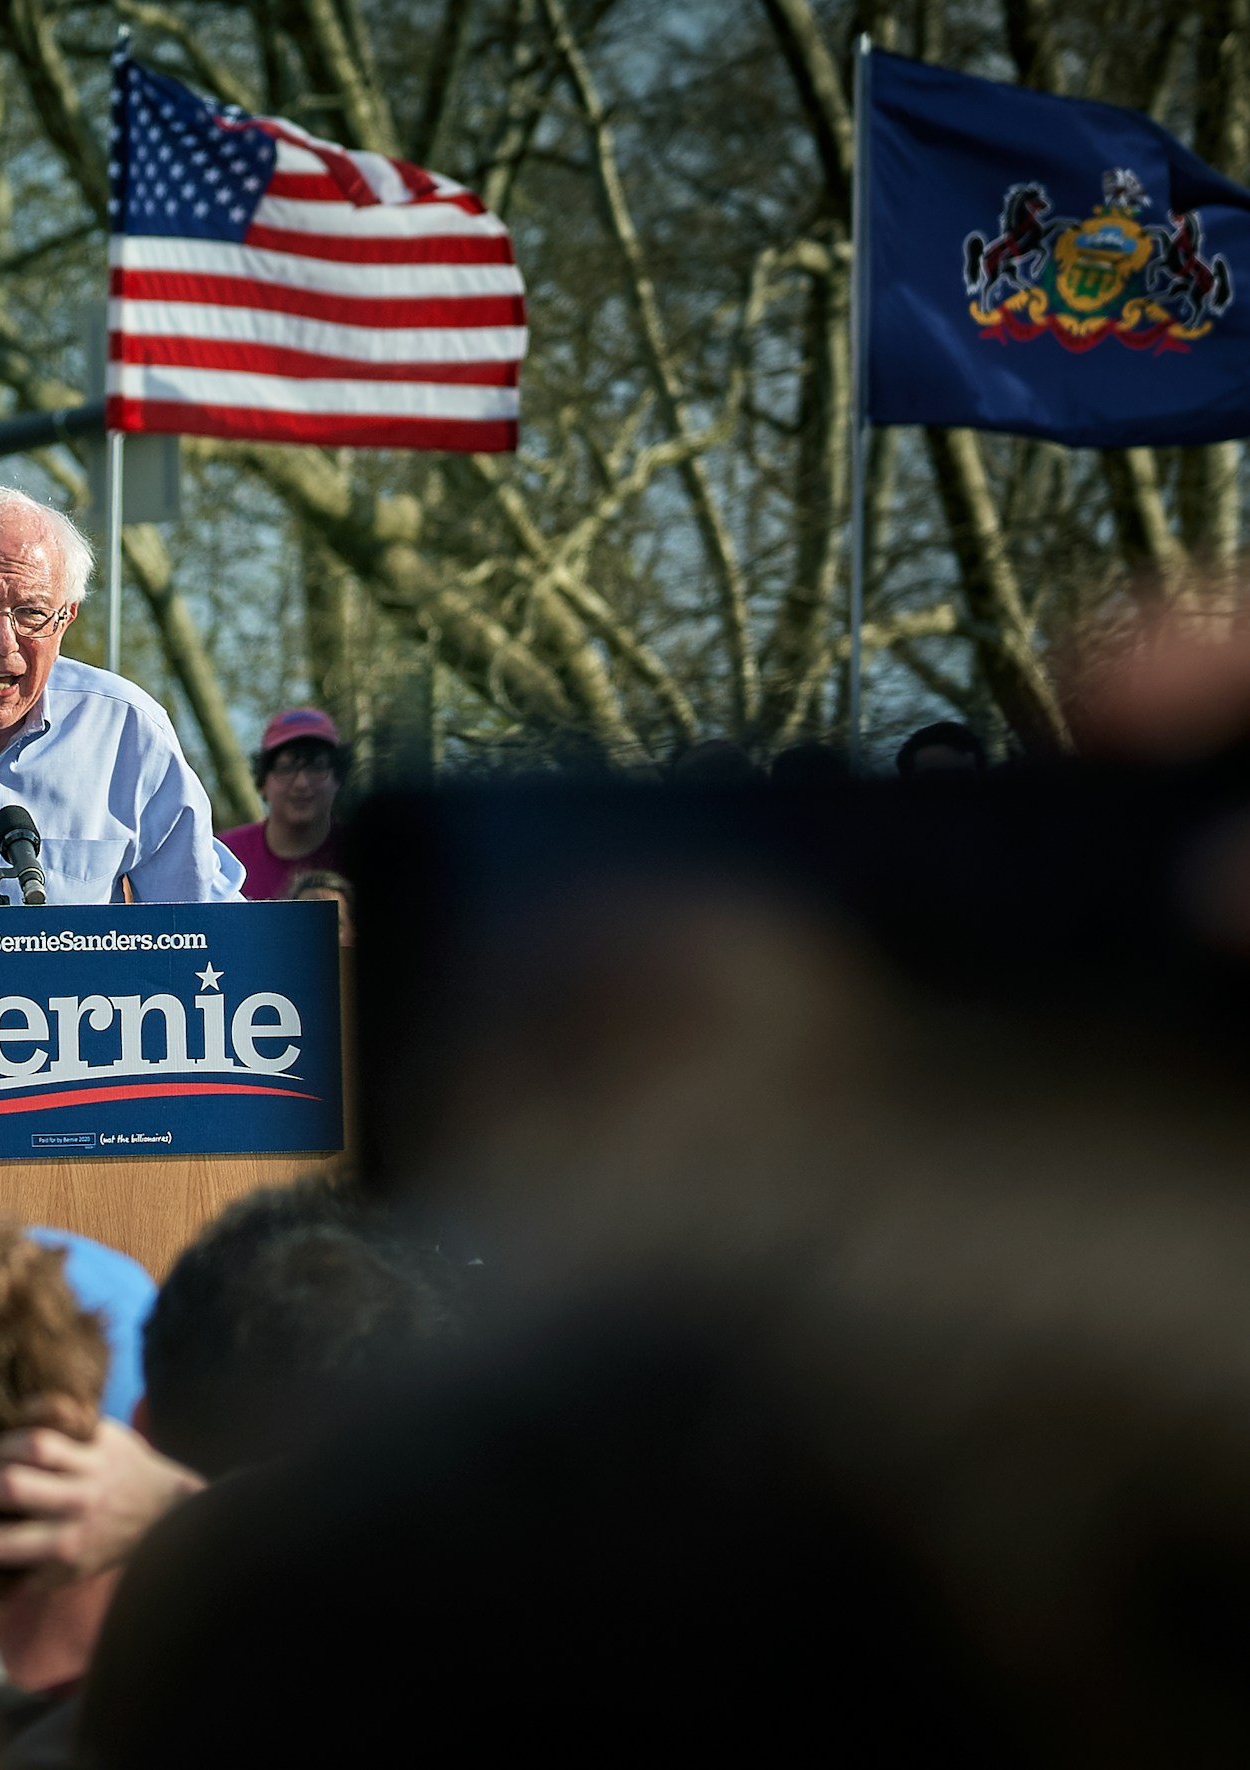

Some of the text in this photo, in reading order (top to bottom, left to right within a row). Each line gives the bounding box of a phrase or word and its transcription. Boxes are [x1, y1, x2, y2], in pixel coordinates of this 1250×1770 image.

[100, 1131, 172, 1145] (not the billionaires)
